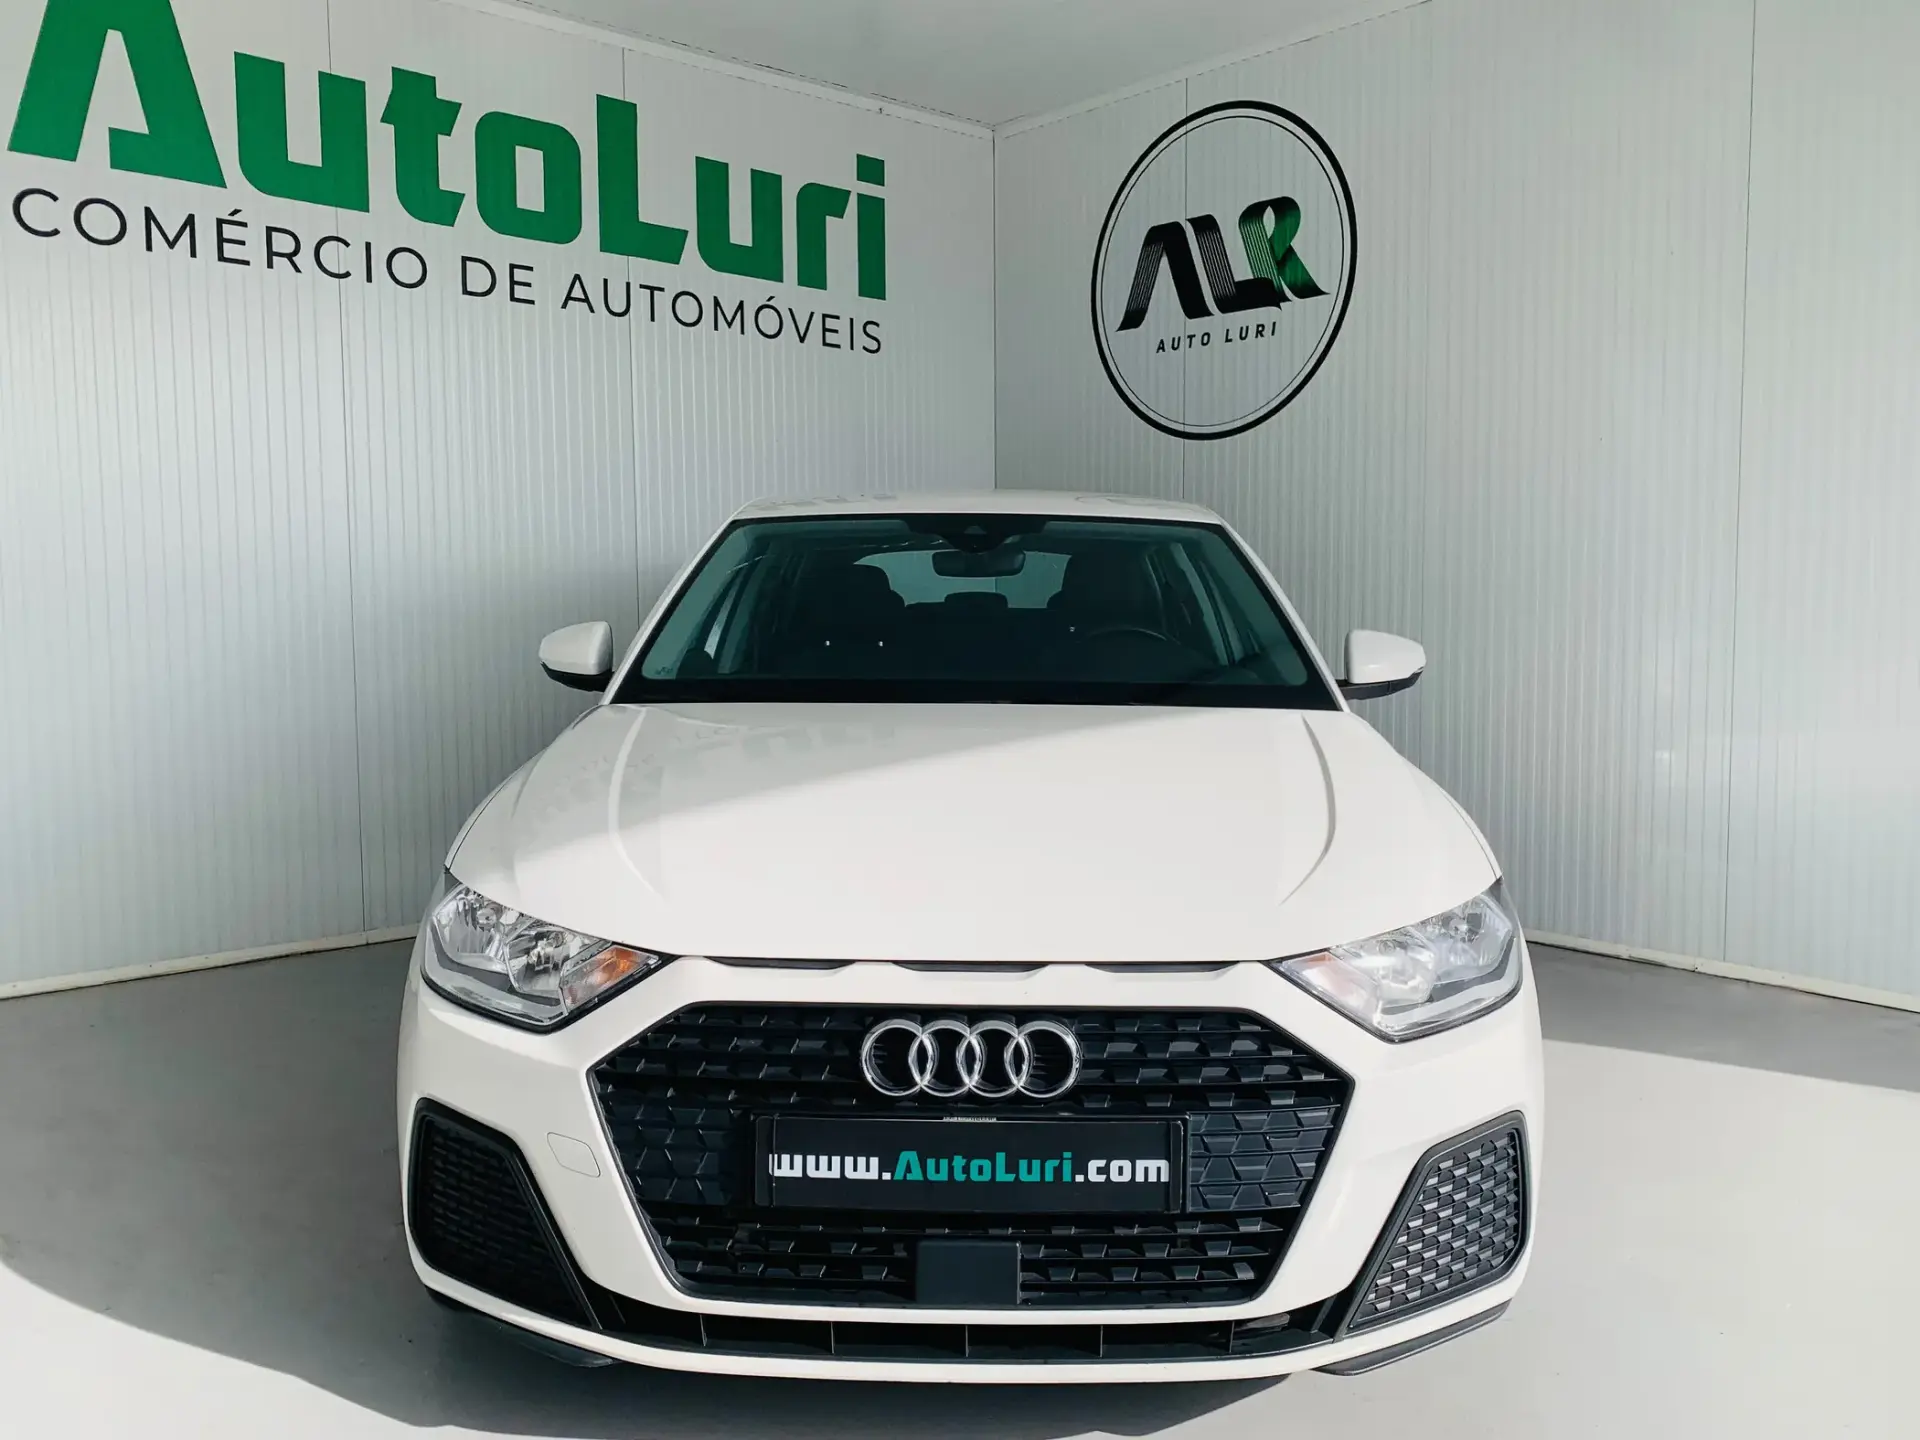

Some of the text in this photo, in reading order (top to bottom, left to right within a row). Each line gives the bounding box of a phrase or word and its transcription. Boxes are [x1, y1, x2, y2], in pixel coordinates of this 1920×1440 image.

[8, 0, 886, 300] AutoLuri
[12, 188, 882, 354] COMÉRCIO DE AUTOMÓVEIS
[1116, 196, 1330, 332] ALR
[1156, 321, 1277, 354] AUTO LURI
[768, 1151, 1169, 1183] www.AutoLuri.com
